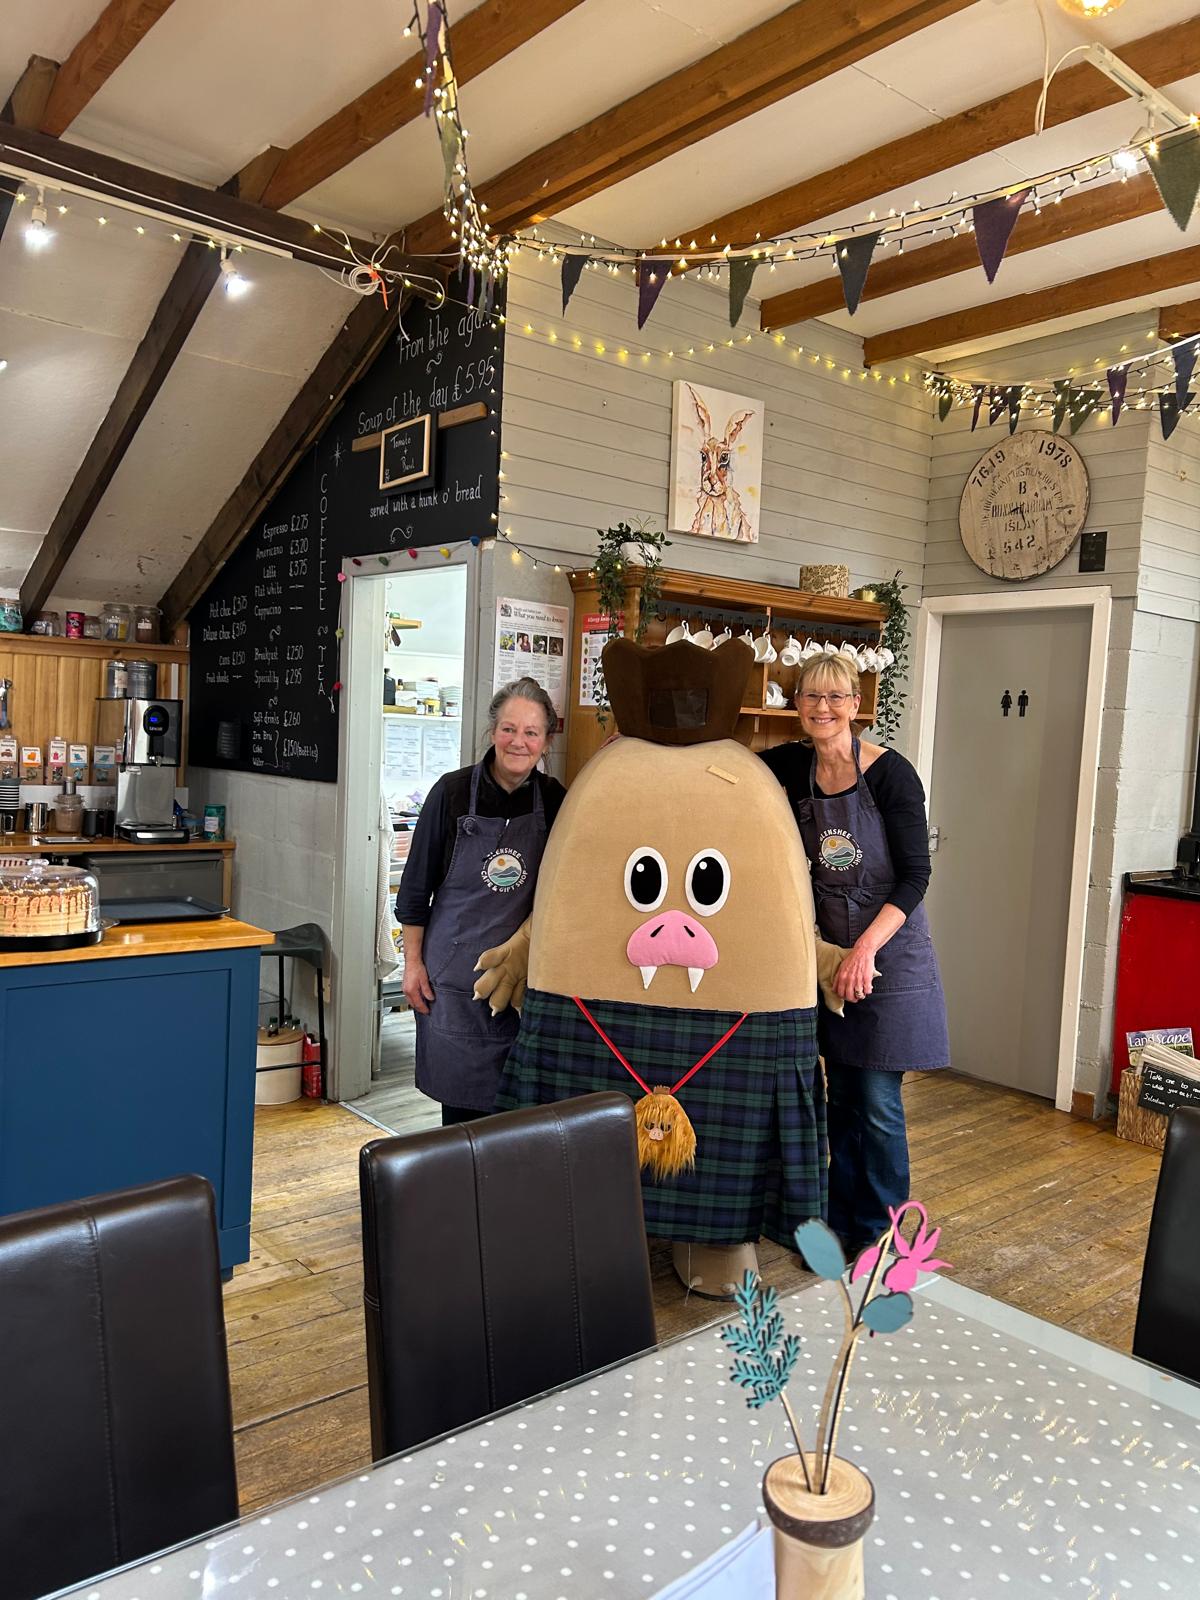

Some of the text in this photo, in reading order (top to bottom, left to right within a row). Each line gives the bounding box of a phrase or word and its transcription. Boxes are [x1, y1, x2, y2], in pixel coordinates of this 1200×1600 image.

[399, 333, 424, 364] From
[428, 314, 449, 351] the
[358, 411, 382, 435] Soup
[386, 396, 398, 421] of
[403, 389, 421, 416] the
[429, 376, 448, 411] day
[1038, 440, 1073, 468] 1978
[369, 500, 389, 518] served
[393, 492, 409, 512] with
[411, 497, 417, 509] a
[418, 488, 438, 508] hunk
[455, 474, 483, 502] bread
[1018, 480, 1027, 494] B
[263, 523, 288, 542] Espresso
[319, 473, 328, 611] COFFEE
[255, 546, 284, 561] Americano
[1003, 534, 1036, 554] 542
[254, 583, 266, 597] Flat
[318, 645, 327, 696] TEA
[253, 711, 263, 726] Soft
[264, 711, 280, 725] drinks
[263, 730, 272, 741] Bru
[252, 744, 263, 754] Coke
[853, 849, 863, 865] SHOP
[481, 871, 493, 888] CAFE
[515, 870, 528, 888] SHOP
[1147, 1069, 1163, 1081] Take
[1180, 1081, 1189, 1090] to
